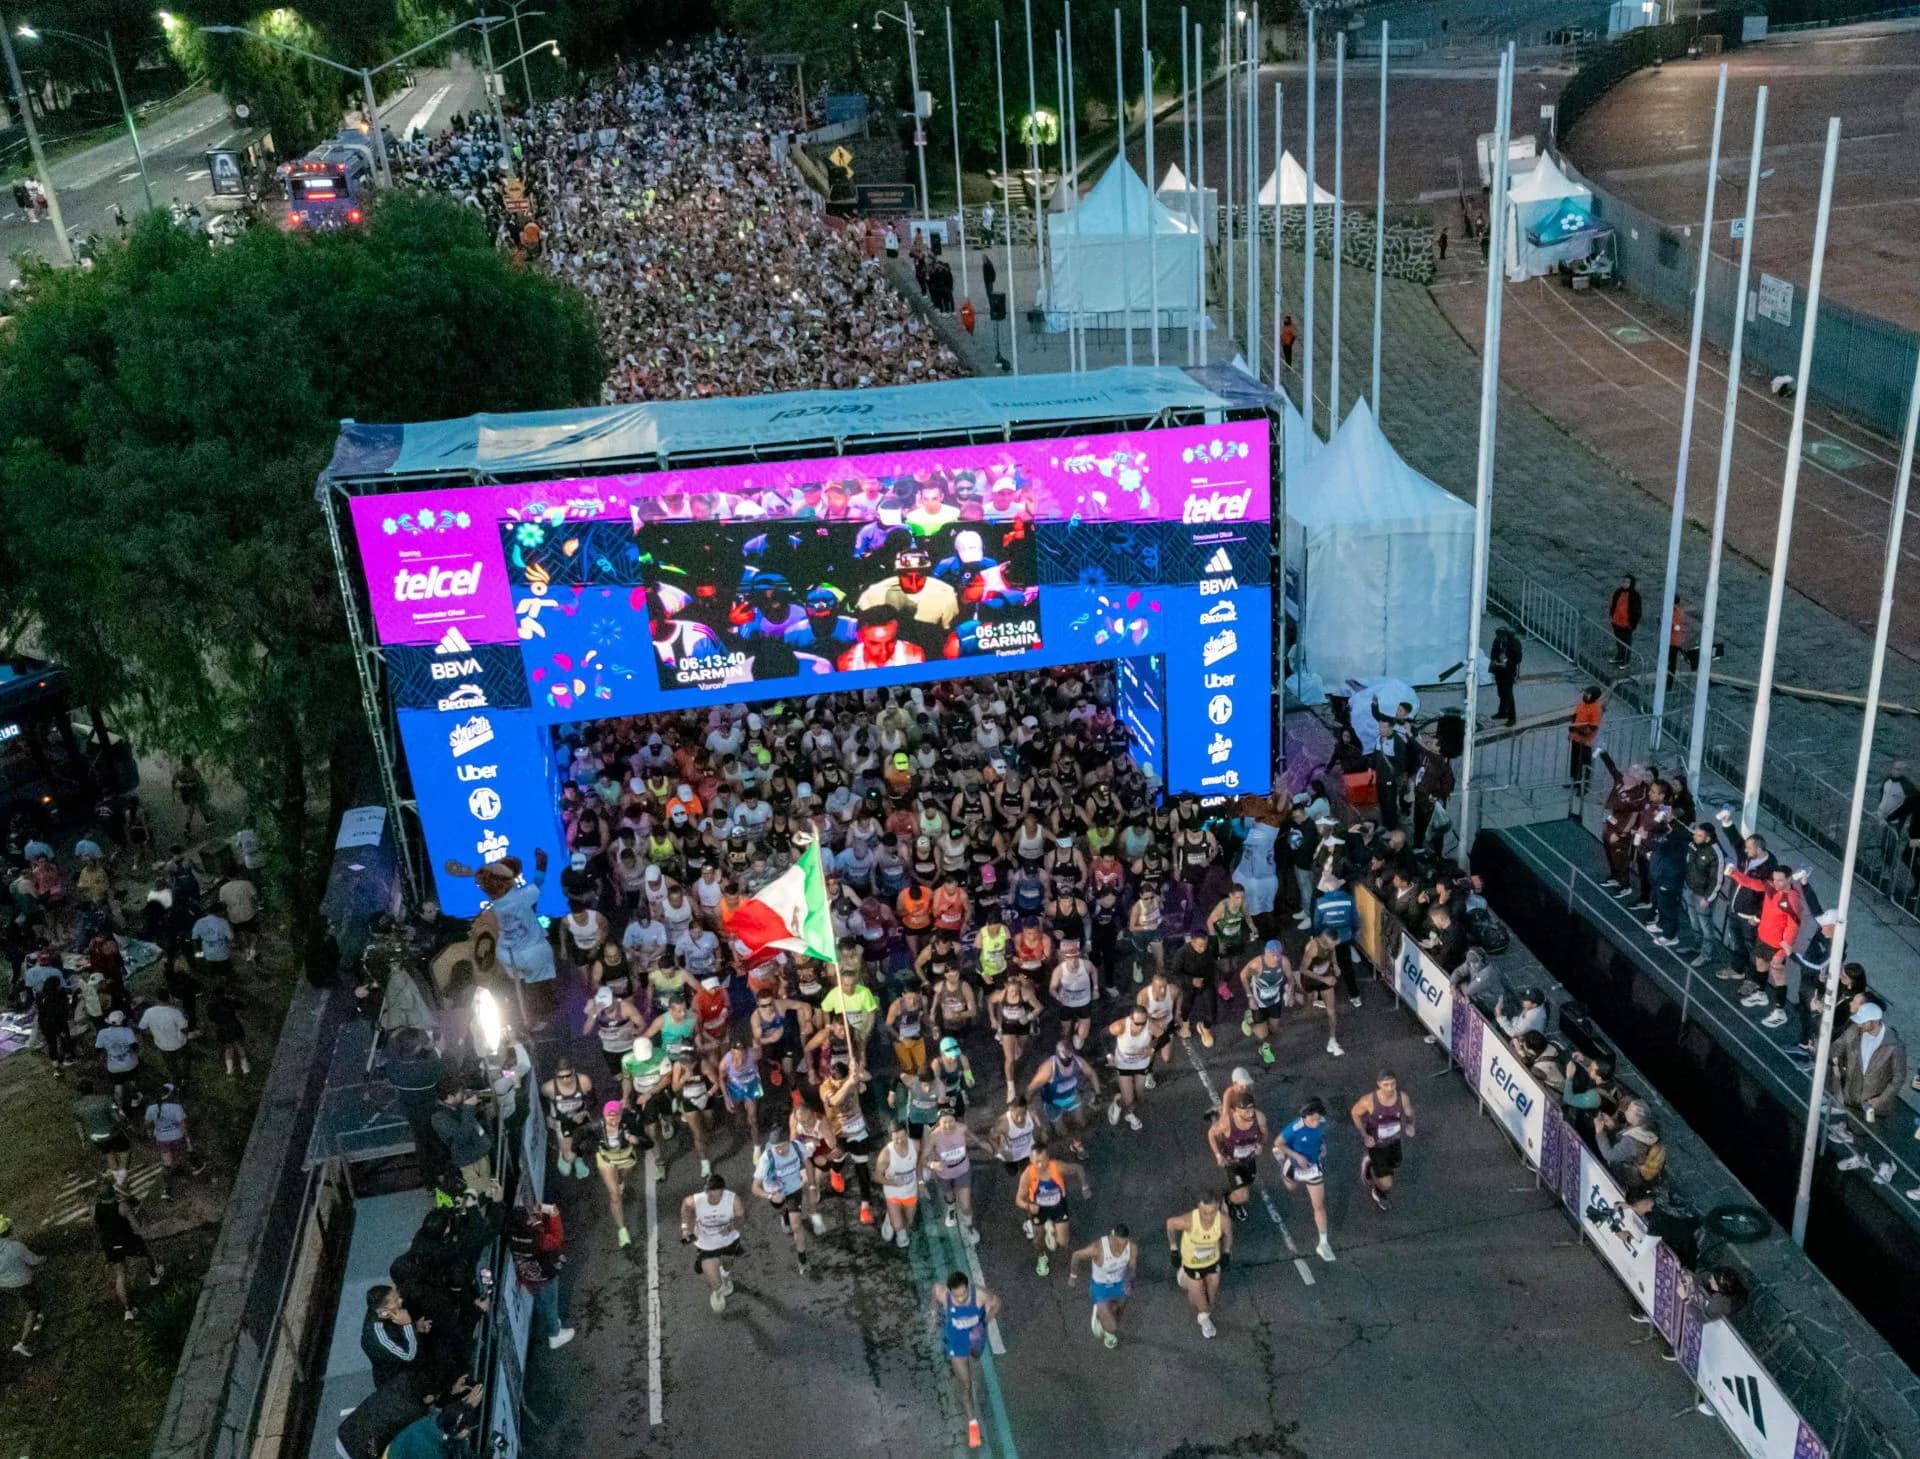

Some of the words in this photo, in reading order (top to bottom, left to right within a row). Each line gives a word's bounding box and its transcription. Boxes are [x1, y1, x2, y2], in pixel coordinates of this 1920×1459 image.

[768, 404, 875, 423] telcel
[1182, 488, 1252, 524] telcel
[394, 561, 483, 601] telcel
[1200, 576, 1238, 596] BBVA
[976, 620, 1036, 638] 06:13:40
[978, 632, 1039, 649] GARMIN
[431, 657, 483, 680] BBVA
[680, 652, 745, 671] 06:13:40
[676, 666, 744, 682] GARMIN
[1204, 673, 1236, 688] Uber
[457, 764, 498, 782] Uber
[470, 789, 500, 819] MG
[1402, 953, 1444, 1007] telcel
[1490, 1055, 1534, 1118] telcel
